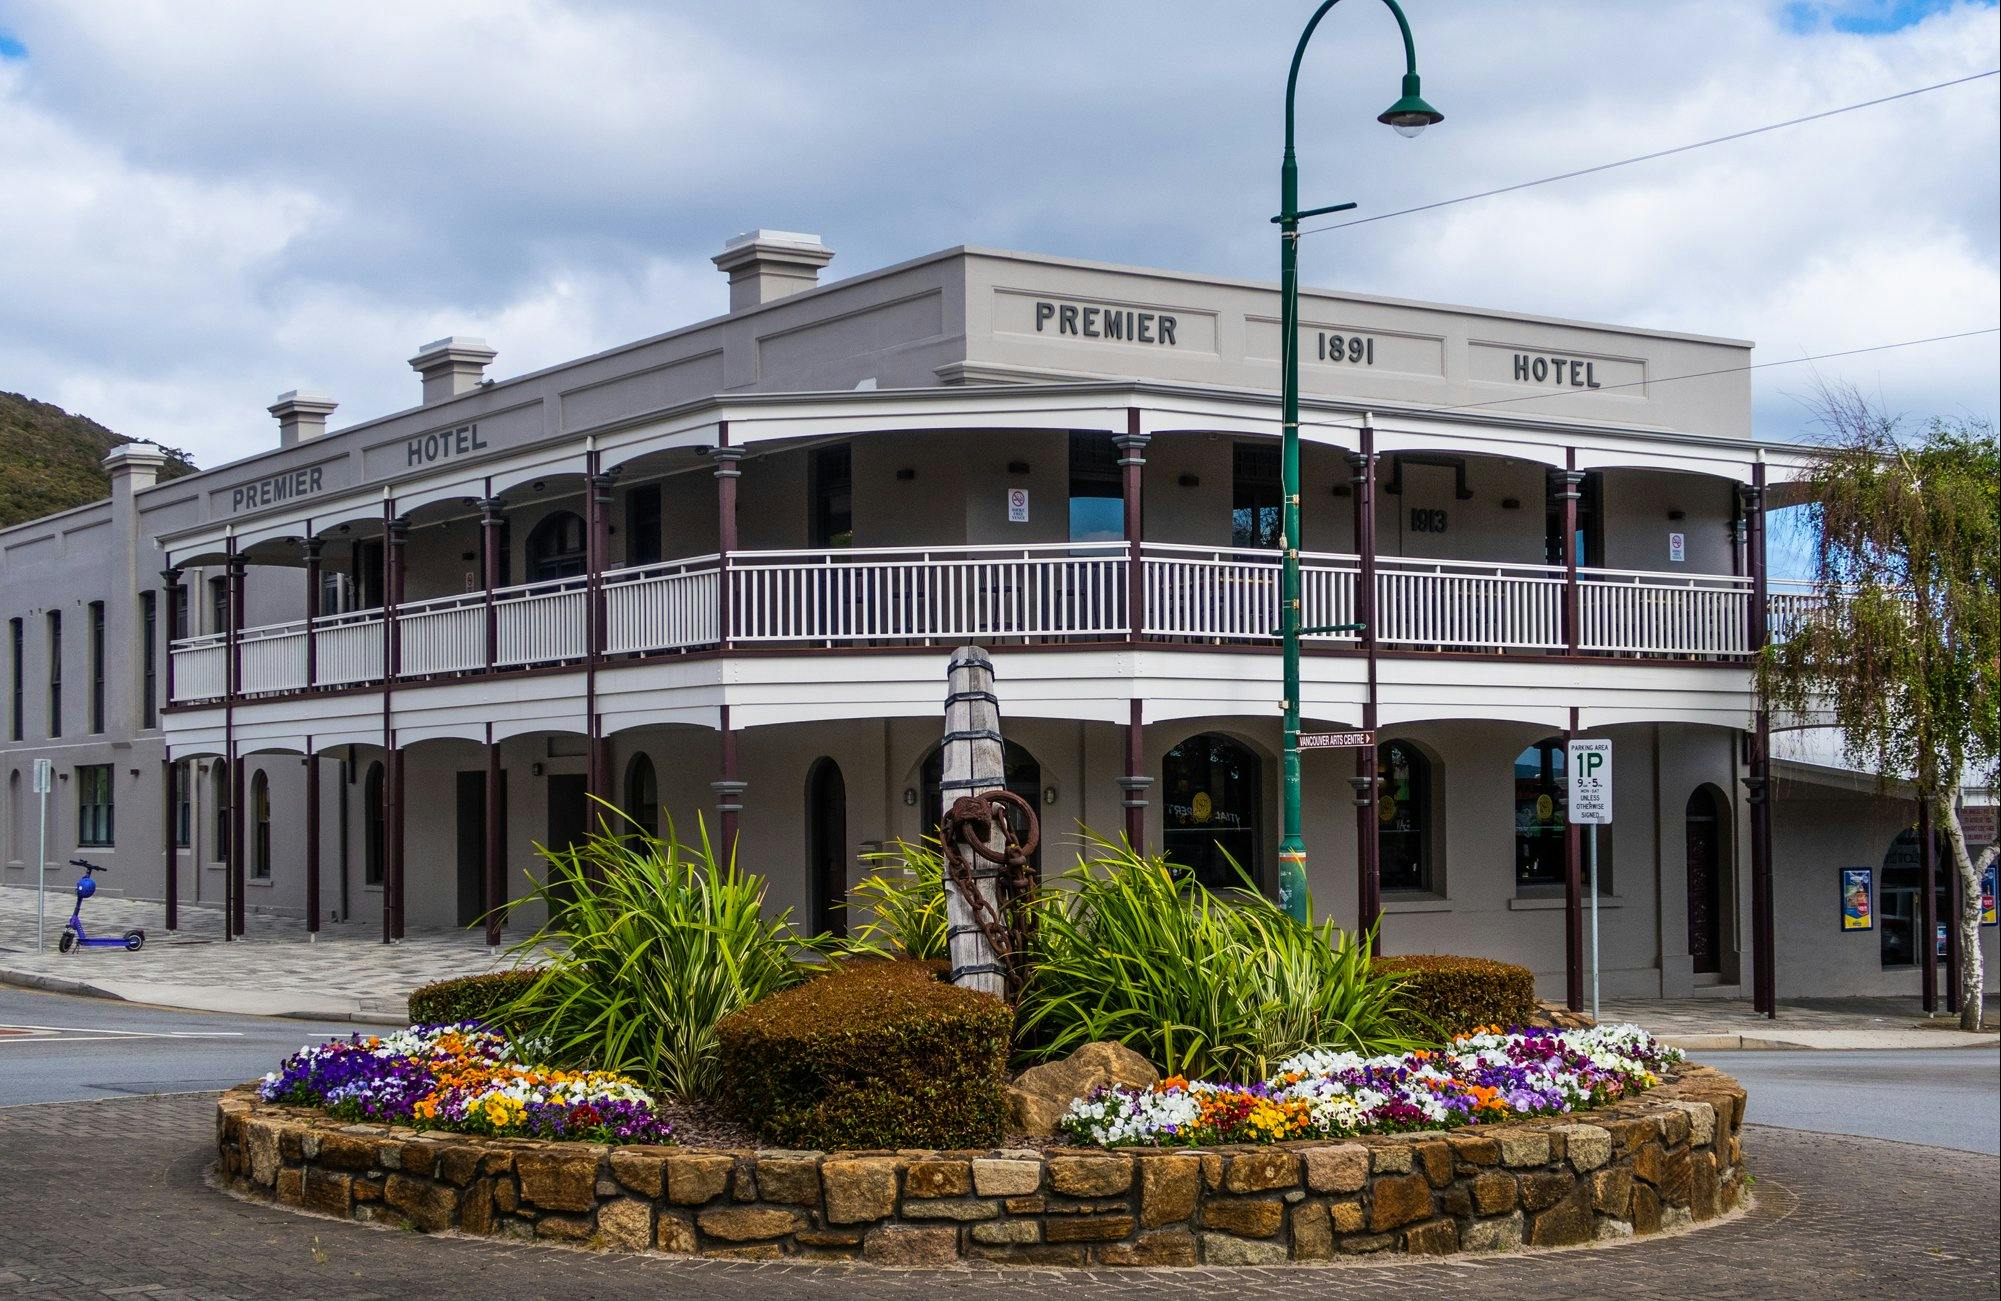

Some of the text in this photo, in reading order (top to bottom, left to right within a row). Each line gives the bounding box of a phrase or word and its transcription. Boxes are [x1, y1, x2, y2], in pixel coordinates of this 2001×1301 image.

[1036, 301, 1178, 345] PREMIER
[1318, 332, 1374, 365] 1891
[1514, 354, 1601, 388] HOTEL
[407, 424, 488, 467] HOTEL
[232, 466, 323, 513] PREMIER
[1411, 508, 1448, 533] 1913
[1300, 734, 1364, 746] VANCOUVER ARTS CENTRE
[1577, 752, 1603, 777] 1P
